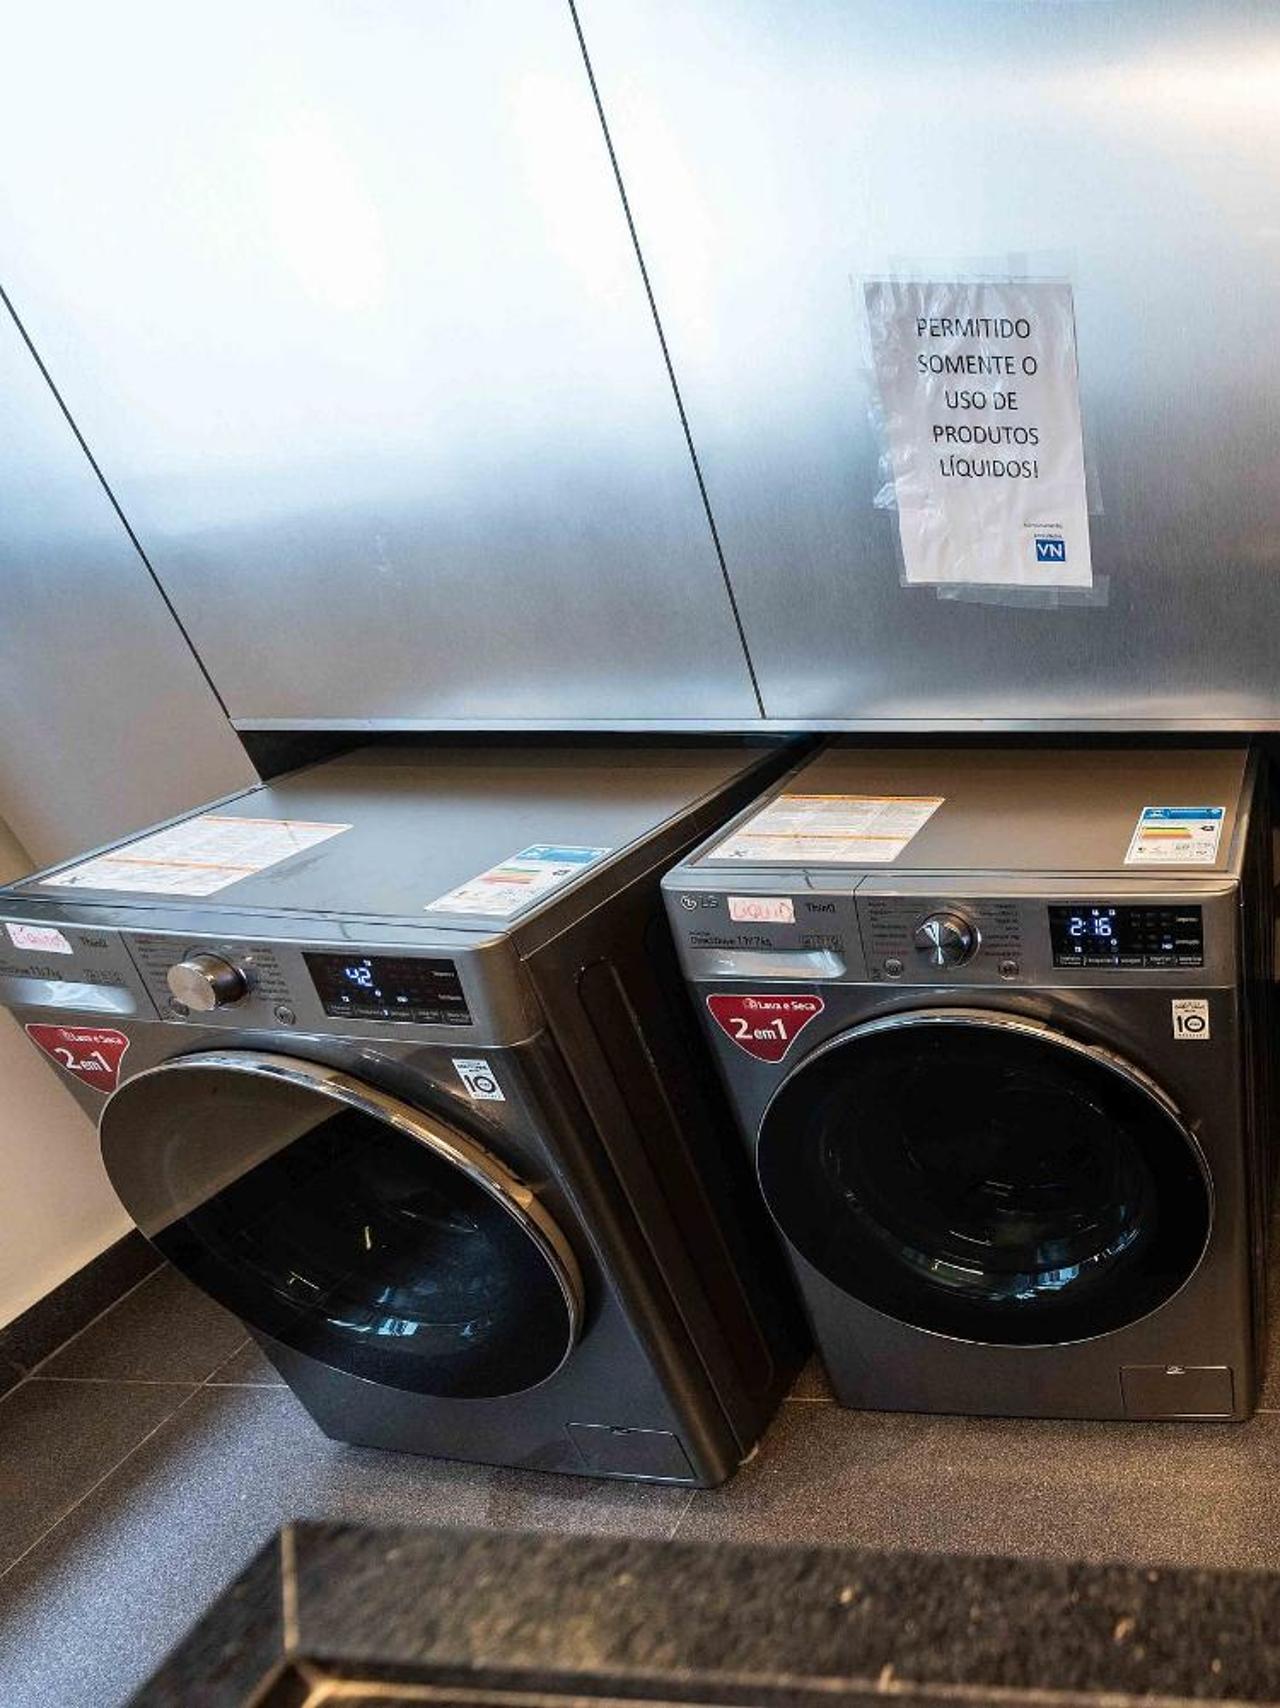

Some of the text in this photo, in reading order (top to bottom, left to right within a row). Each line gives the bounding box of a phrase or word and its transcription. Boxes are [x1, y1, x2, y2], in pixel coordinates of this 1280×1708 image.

[916, 317, 1031, 339] PERMITIDO
[917, 355, 1038, 375] SOMENTE O
[945, 391, 1018, 410] USO DE
[933, 425, 1040, 446] PRODUTOS
[939, 455, 1039, 479] LÍQUIDOS!
[1037, 543, 1064, 557] VN
[1070, 917, 1111, 936] 2:16
